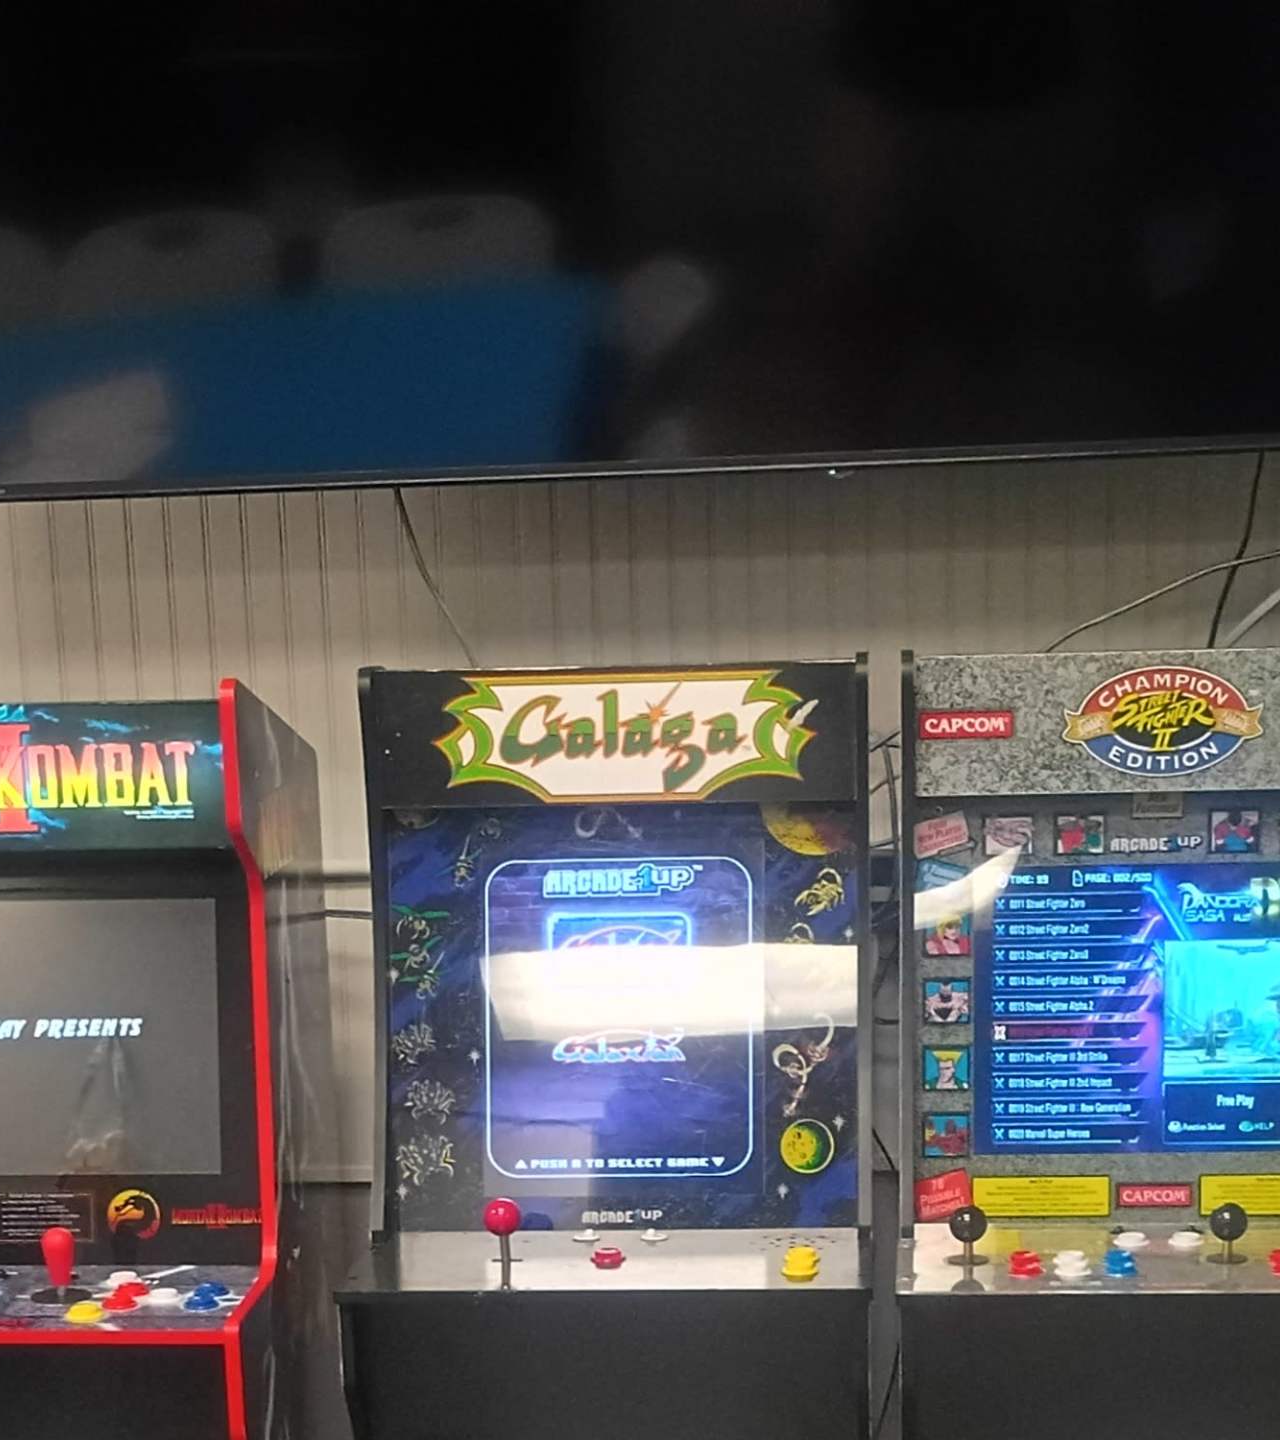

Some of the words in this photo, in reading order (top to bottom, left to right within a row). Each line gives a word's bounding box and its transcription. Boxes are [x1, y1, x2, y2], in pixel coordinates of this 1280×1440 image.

[1098, 673, 1228, 707] CHAMPION
[925, 716, 1010, 734] CAPCOM
[499, 689, 745, 791] Galaga
[1109, 742, 1219, 770] EDITION
[33, 1018, 143, 1039] PRESENTS
[1122, 1188, 1186, 1203] CAPCOM
